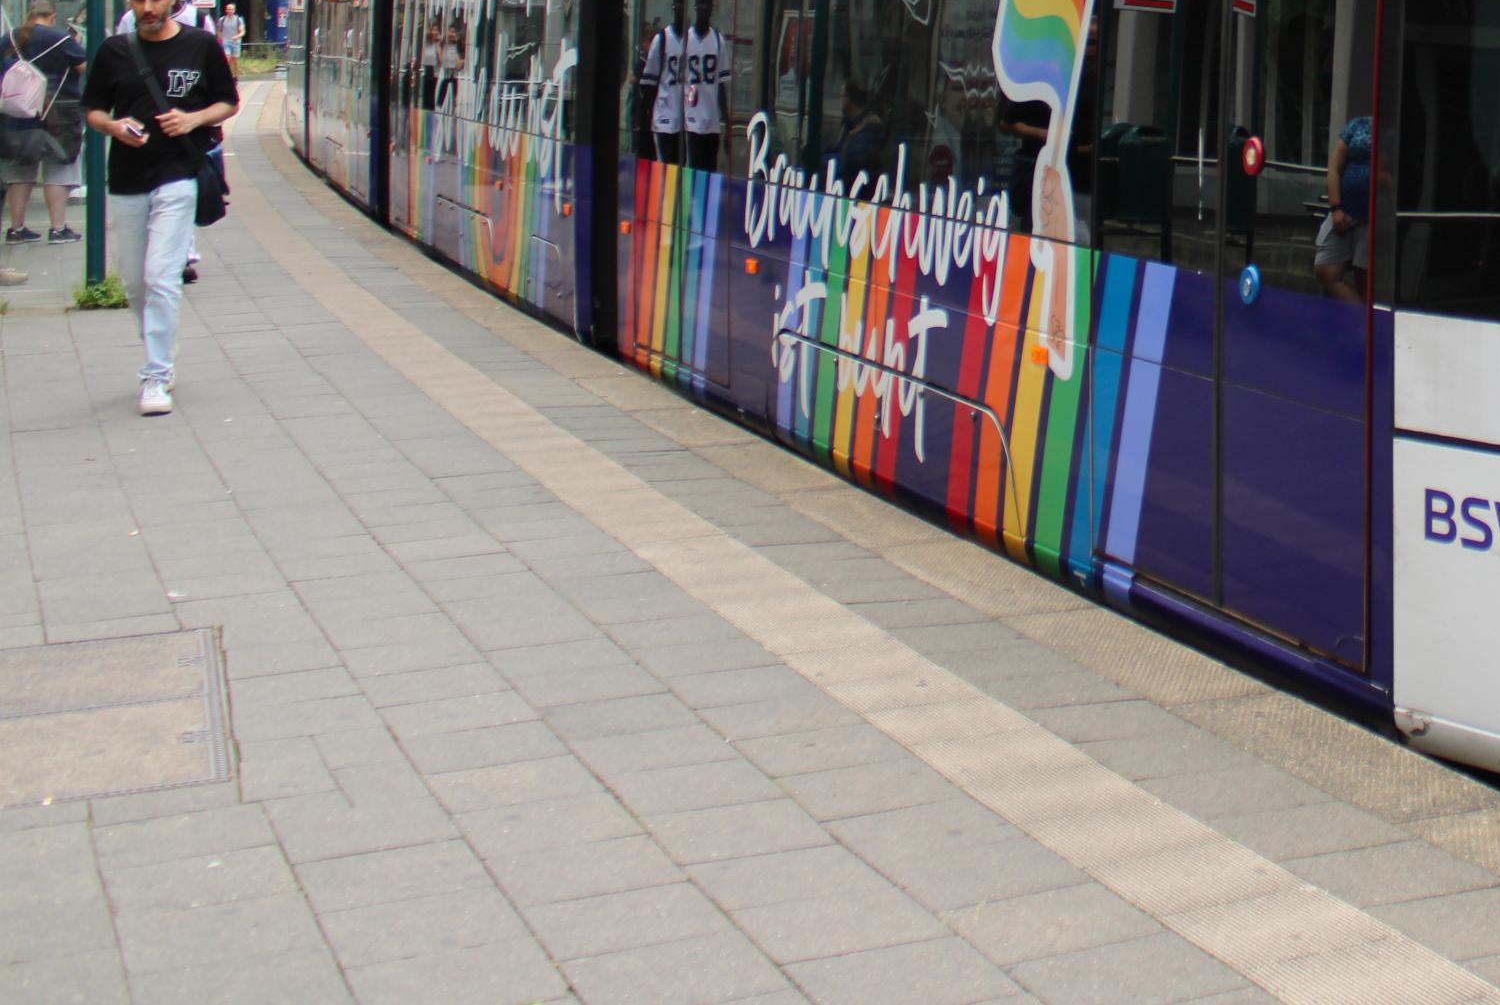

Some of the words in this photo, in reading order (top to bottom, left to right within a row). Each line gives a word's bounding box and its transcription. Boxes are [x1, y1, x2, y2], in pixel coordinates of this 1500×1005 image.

[745, 110, 1010, 327] Braunschweig
[772, 270, 827, 419] ist
[836, 293, 948, 464] bunt
